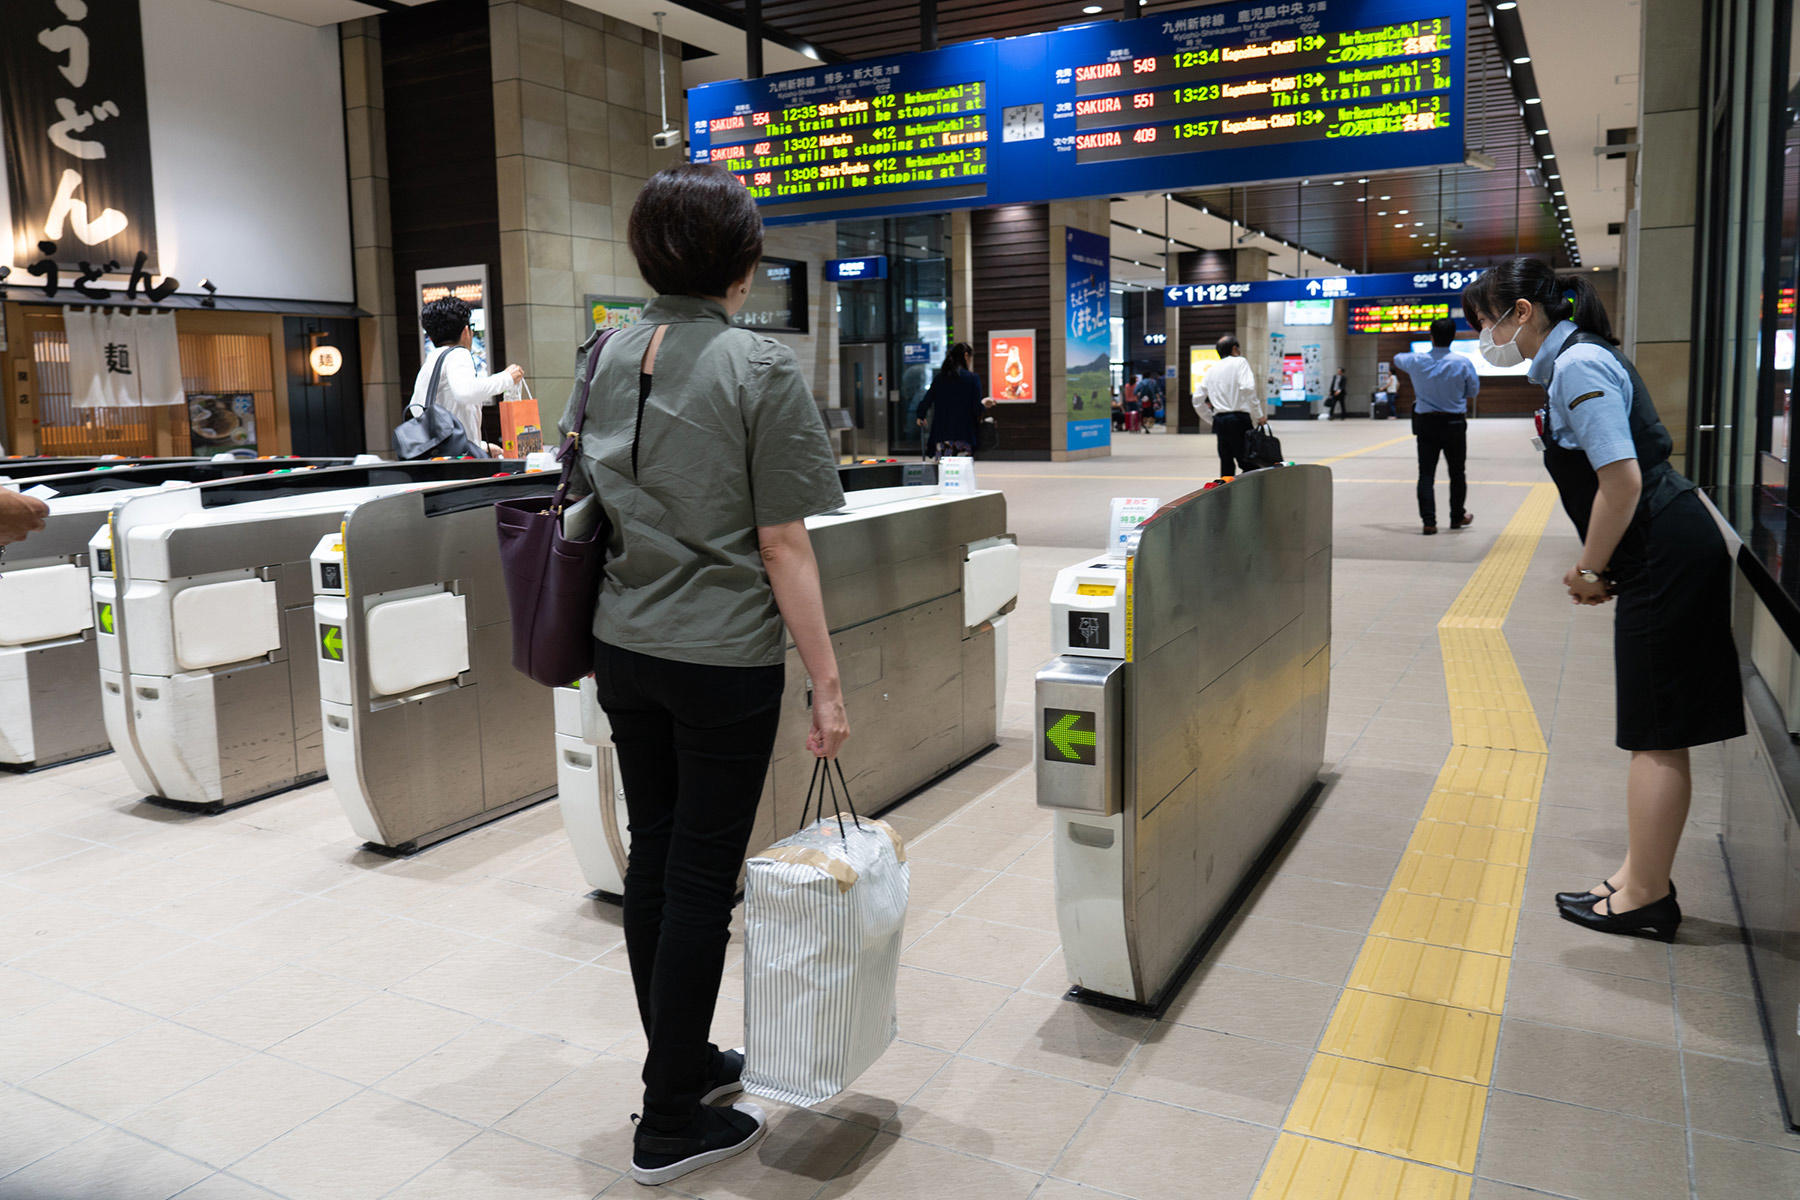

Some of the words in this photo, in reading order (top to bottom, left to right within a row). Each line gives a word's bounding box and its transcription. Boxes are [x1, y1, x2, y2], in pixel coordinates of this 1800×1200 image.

[1238, 2, 1304, 23] 鹿児島中央
[1076, 62, 1122, 82] SAKURA
[1133, 57, 1156, 74] 549
[1174, 48, 1220, 68] 12:34
[1296, 36, 1314, 52] 13
[1076, 97, 1122, 116] SAKURA
[1133, 92, 1154, 109] 551
[1174, 84, 1220, 104] 13:23
[1296, 74, 1314, 89] 13
[1271, 92, 1310, 107] This
[1320, 84, 1371, 102] train
[1382, 76, 1422, 95] will
[38, 0, 128, 246] うどん
[710, 116, 745, 132] SAKURA
[752, 112, 770, 126] 554
[782, 105, 817, 122] 12:35
[882, 94, 896, 108] 12
[765, 123, 792, 137] This
[798, 117, 834, 132] train
[840, 111, 868, 127] will
[875, 109, 891, 122] be
[897, 102, 958, 119] stopping
[965, 96, 981, 110] at
[1076, 132, 1122, 150] SAKURA
[1133, 128, 1156, 143] 409
[1174, 120, 1220, 139] 13:57
[1296, 110, 1313, 126] 13
[710, 146, 745, 161] SAKURA
[753, 142, 771, 156] 402
[783, 136, 818, 152] 13:02
[818, 133, 853, 147] Hakata
[882, 126, 896, 140] 12
[726, 158, 753, 171] This
[758, 152, 793, 168] train
[798, 148, 826, 162] will
[833, 146, 848, 158] be
[854, 139, 913, 156] stopping
[919, 135, 935, 148] at
[754, 172, 771, 186] 584
[784, 167, 819, 182] 13:08
[883, 158, 897, 171] 12
[777, 181, 811, 195] train
[817, 176, 845, 191] will
[852, 175, 868, 187] be
[873, 168, 933, 185] stopping
[940, 165, 955, 178] at
[962, 163, 986, 175] Kur
[27, 240, 180, 303] うどん
[1439, 271, 1478, 289] 13·1
[105, 342, 132, 375] 麺
